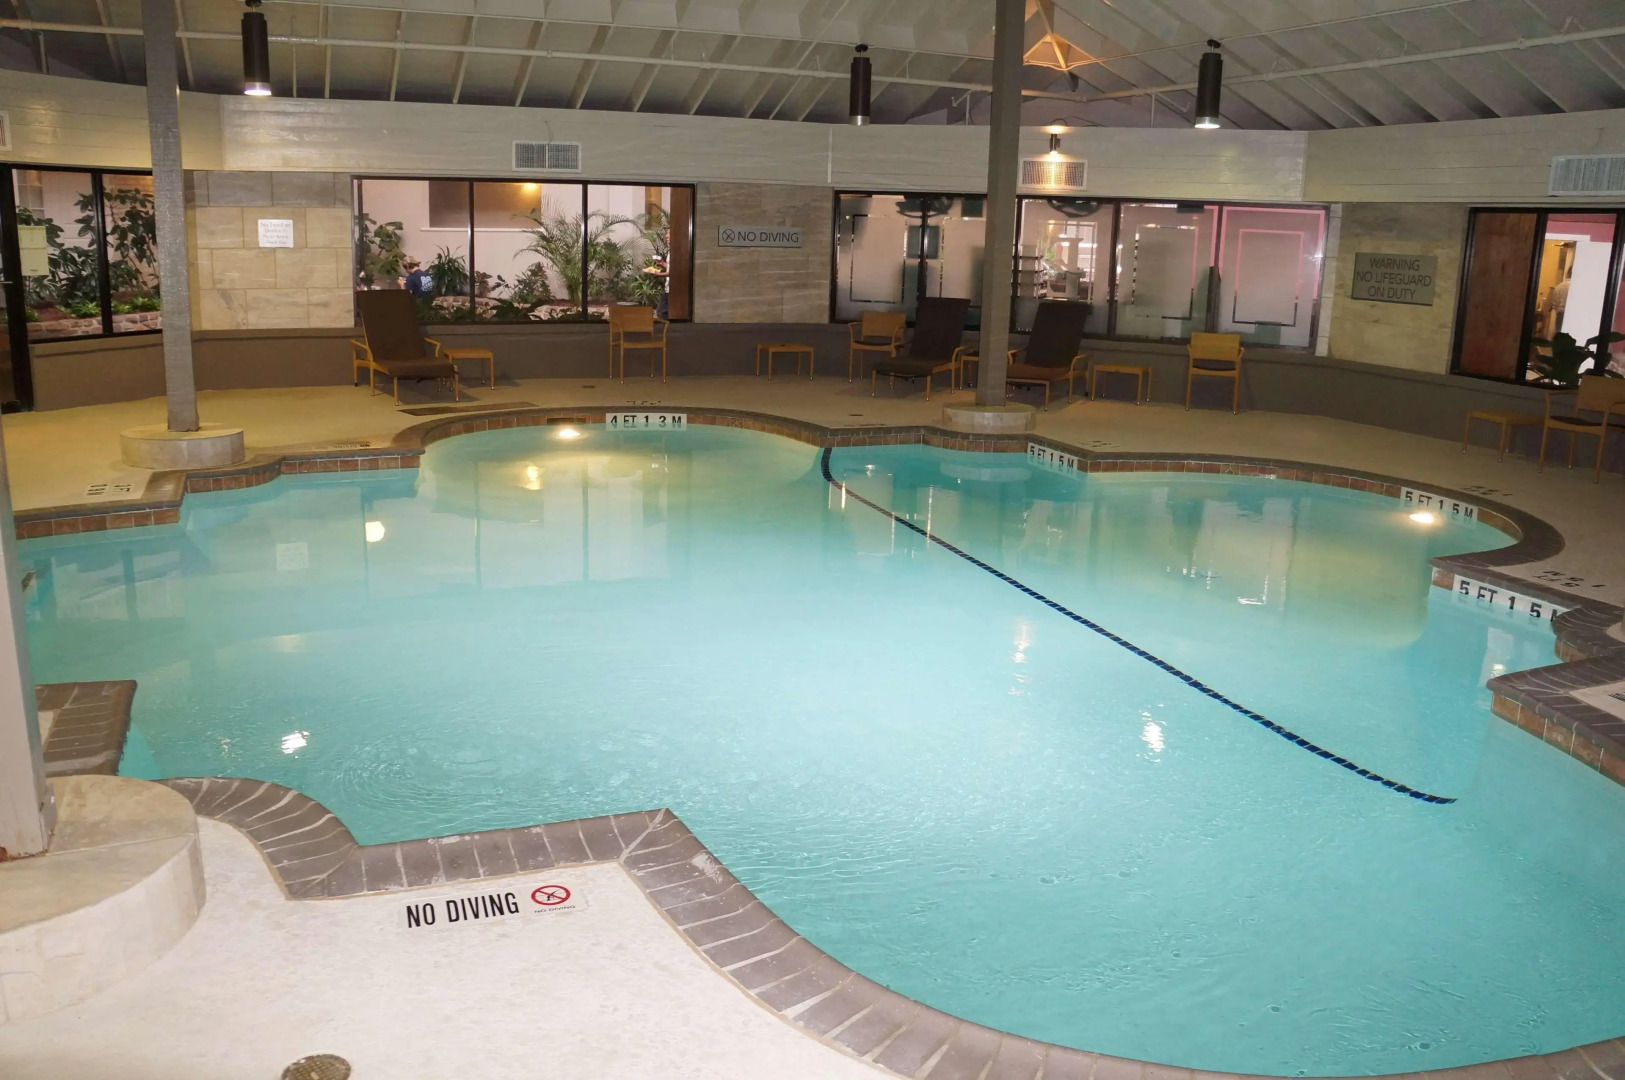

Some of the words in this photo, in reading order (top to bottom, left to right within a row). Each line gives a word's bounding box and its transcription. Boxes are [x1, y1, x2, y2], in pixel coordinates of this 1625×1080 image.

[738, 231, 756, 242] NO
[760, 231, 799, 243] DIVING
[1369, 257, 1420, 271] WARNING
[1356, 270, 1372, 282] NO
[1375, 272, 1432, 287] LIFEGUARD
[1368, 285, 1384, 297] ON
[1387, 287, 1416, 299] DUTY
[623, 415, 637, 423] FT
[1029, 445, 1035, 455] 5
[1037, 448, 1046, 458] FT
[1405, 491, 1413, 501] 5
[1418, 494, 1432, 506] FT
[1438, 499, 1443, 509] 1
[1452, 503, 1460, 514] 5
[1464, 507, 1473, 519] M
[1459, 580, 1470, 595] 5
[1477, 585, 1498, 603] FT
[1508, 596, 1516, 610] 1
[1529, 602, 1542, 618] 5
[406, 902, 436, 928] NO
[446, 892, 519, 923] DIVING
